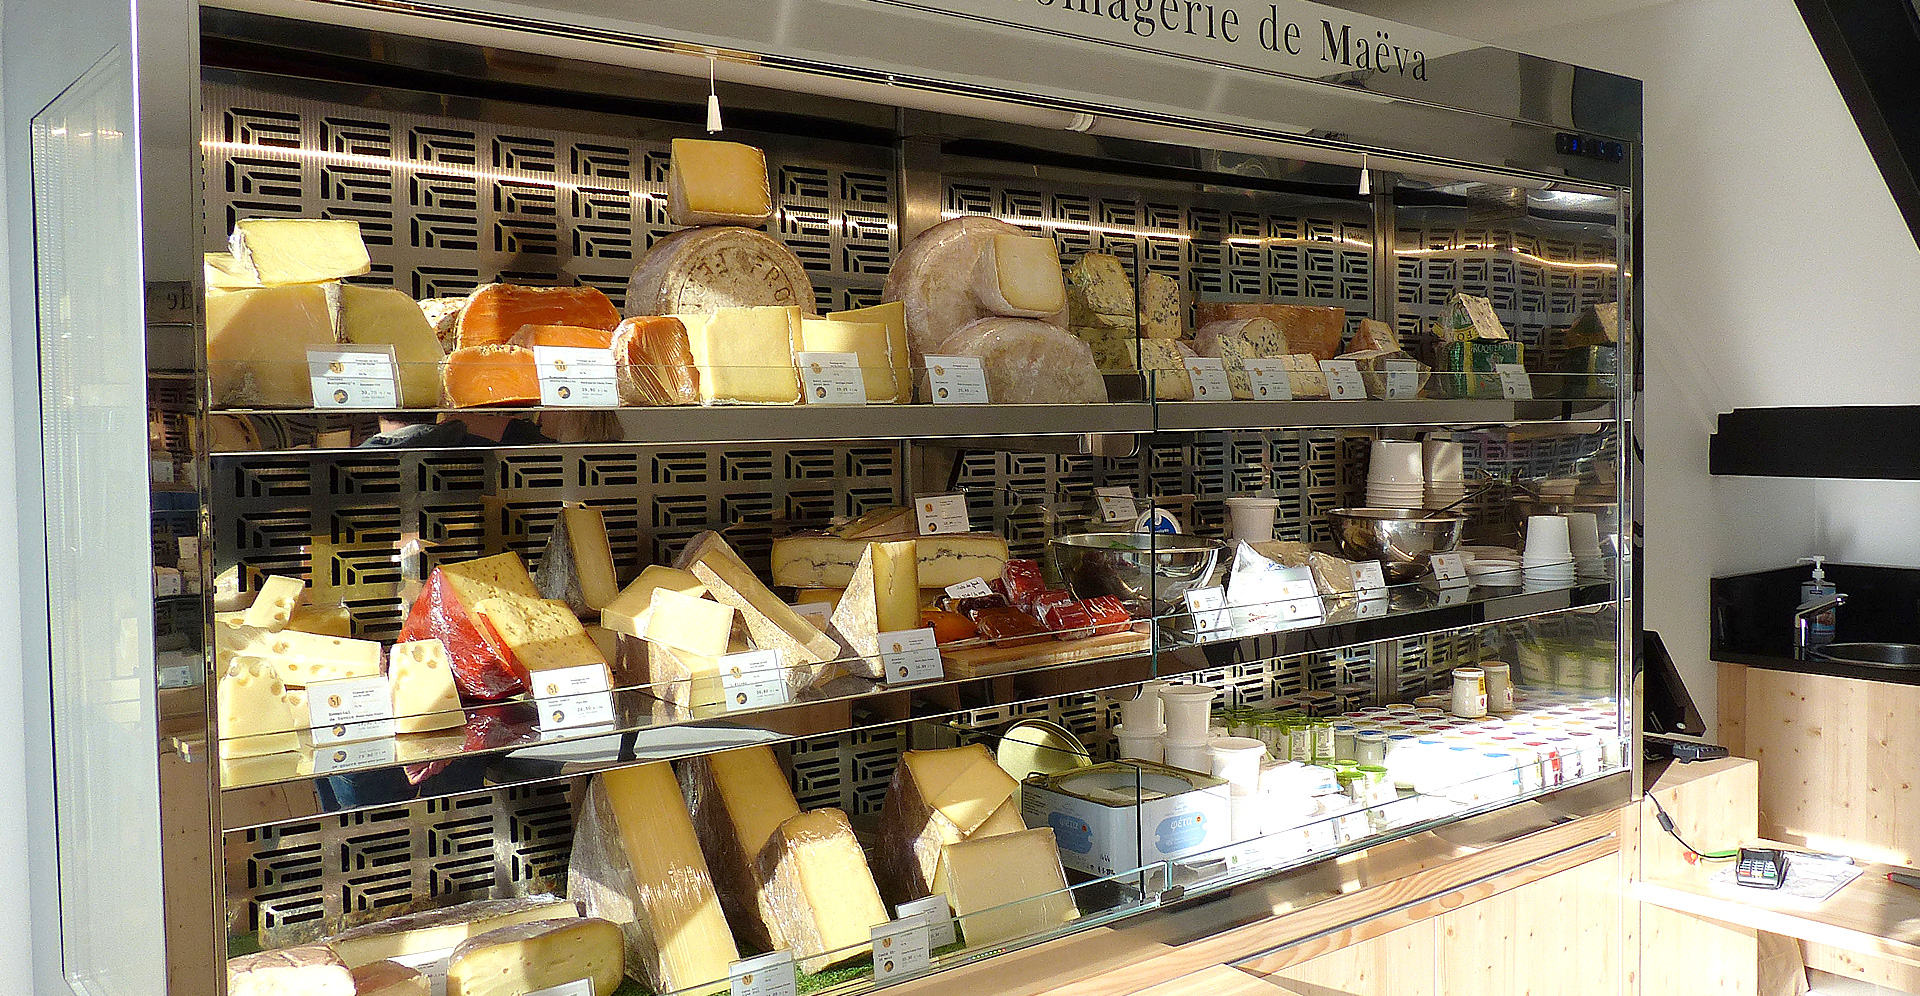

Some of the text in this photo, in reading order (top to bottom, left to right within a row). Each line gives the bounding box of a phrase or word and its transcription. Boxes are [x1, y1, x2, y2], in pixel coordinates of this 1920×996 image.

[1035, 0, 1428, 81] agerie de Maëva
[1170, 816, 1193, 831] φέτα
